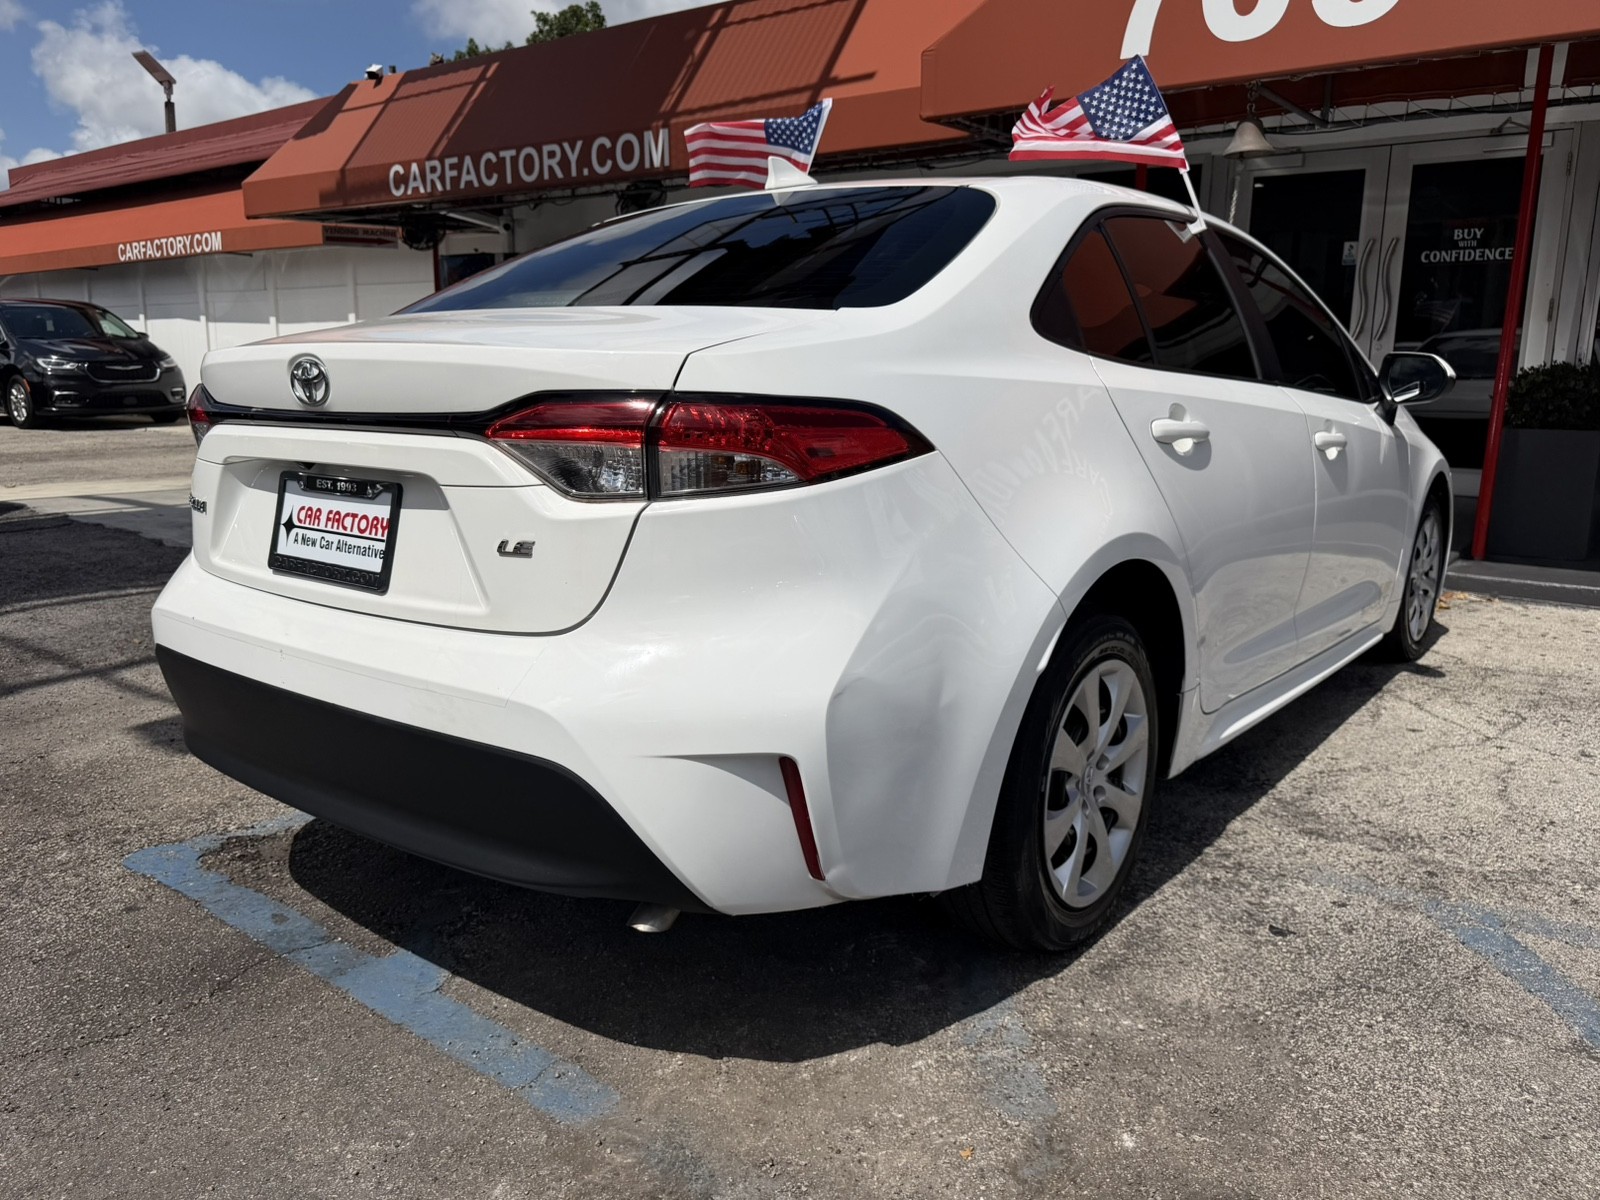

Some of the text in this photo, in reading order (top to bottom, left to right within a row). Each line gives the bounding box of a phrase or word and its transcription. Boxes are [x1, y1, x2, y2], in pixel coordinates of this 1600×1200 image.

[388, 128, 670, 197] CARFACTORY.COM
[1453, 228, 1484, 240] BUY
[118, 231, 222, 262] CARFACTORY.COM
[1420, 247, 1514, 263] CONFIDENCE
[316, 479, 357, 493] EST. 1993
[297, 505, 391, 538] CAR FACTORY
[293, 532, 385, 560] A New Car Alternative
[497, 539, 536, 559] LE
